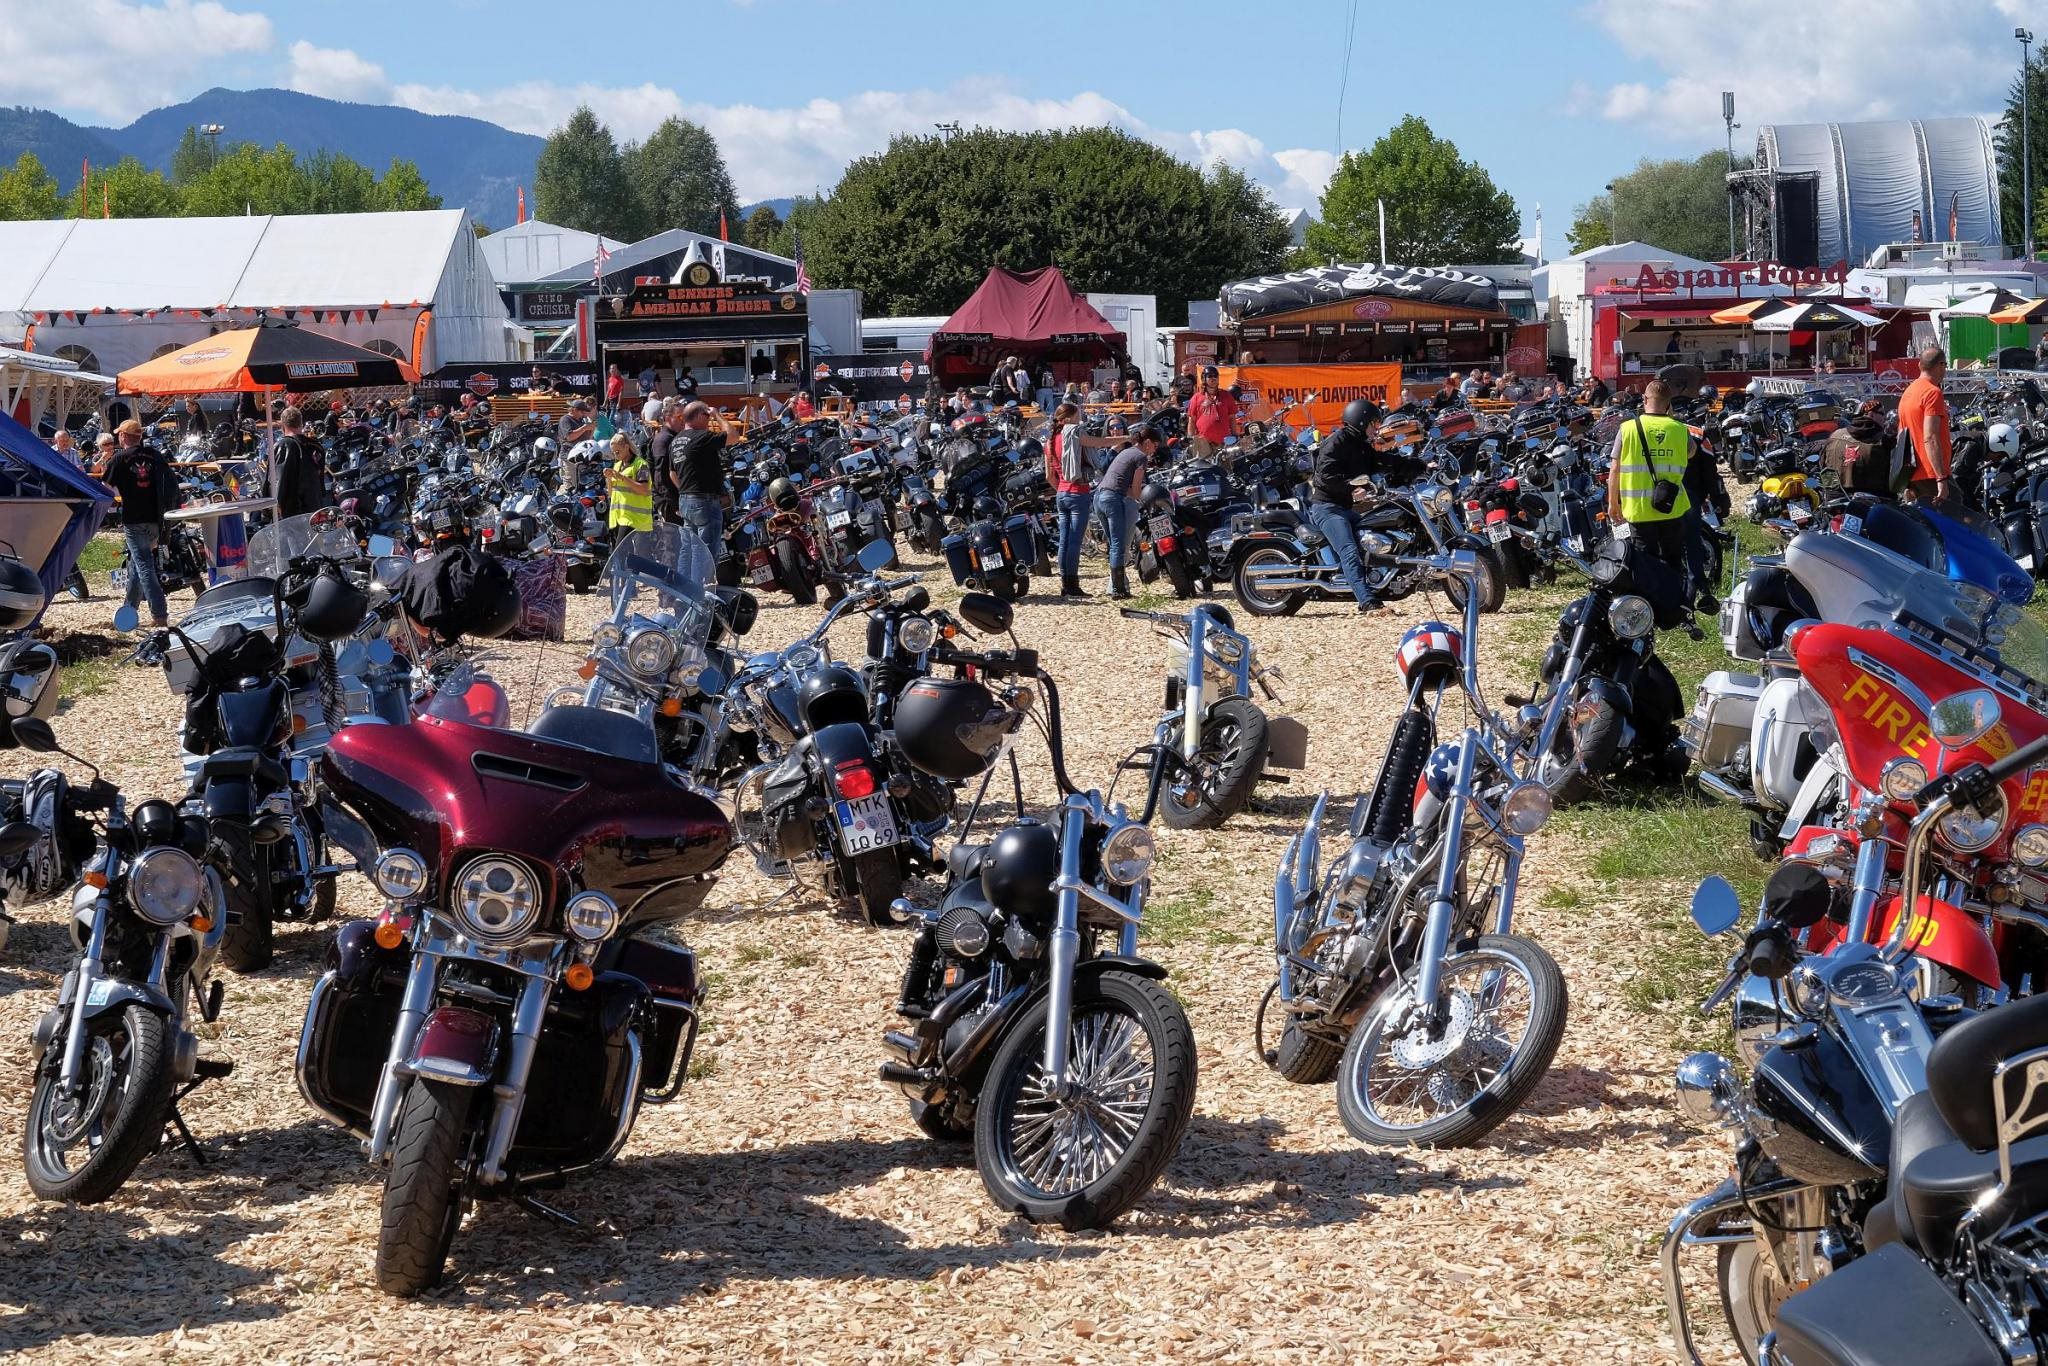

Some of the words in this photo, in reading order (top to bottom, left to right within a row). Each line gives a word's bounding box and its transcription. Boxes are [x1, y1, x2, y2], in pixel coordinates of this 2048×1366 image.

[1634, 263, 1741, 290] Asian
[1757, 259, 1849, 286] Food
[529, 304, 572, 316] CRUISER
[631, 301, 711, 316] AMERICAN
[717, 299, 772, 313] BURGER
[289, 362, 355, 377] HARLEY-DAVIDSON
[1267, 384, 1388, 404] HARLEY-DAVIDSON
[221, 541, 246, 559] Red
[1843, 674, 1933, 759] FIRE
[849, 795, 884, 816] MTK
[850, 836, 871, 853] IQ
[874, 829, 893, 846] 69
[40, 862, 49, 888] HJC
